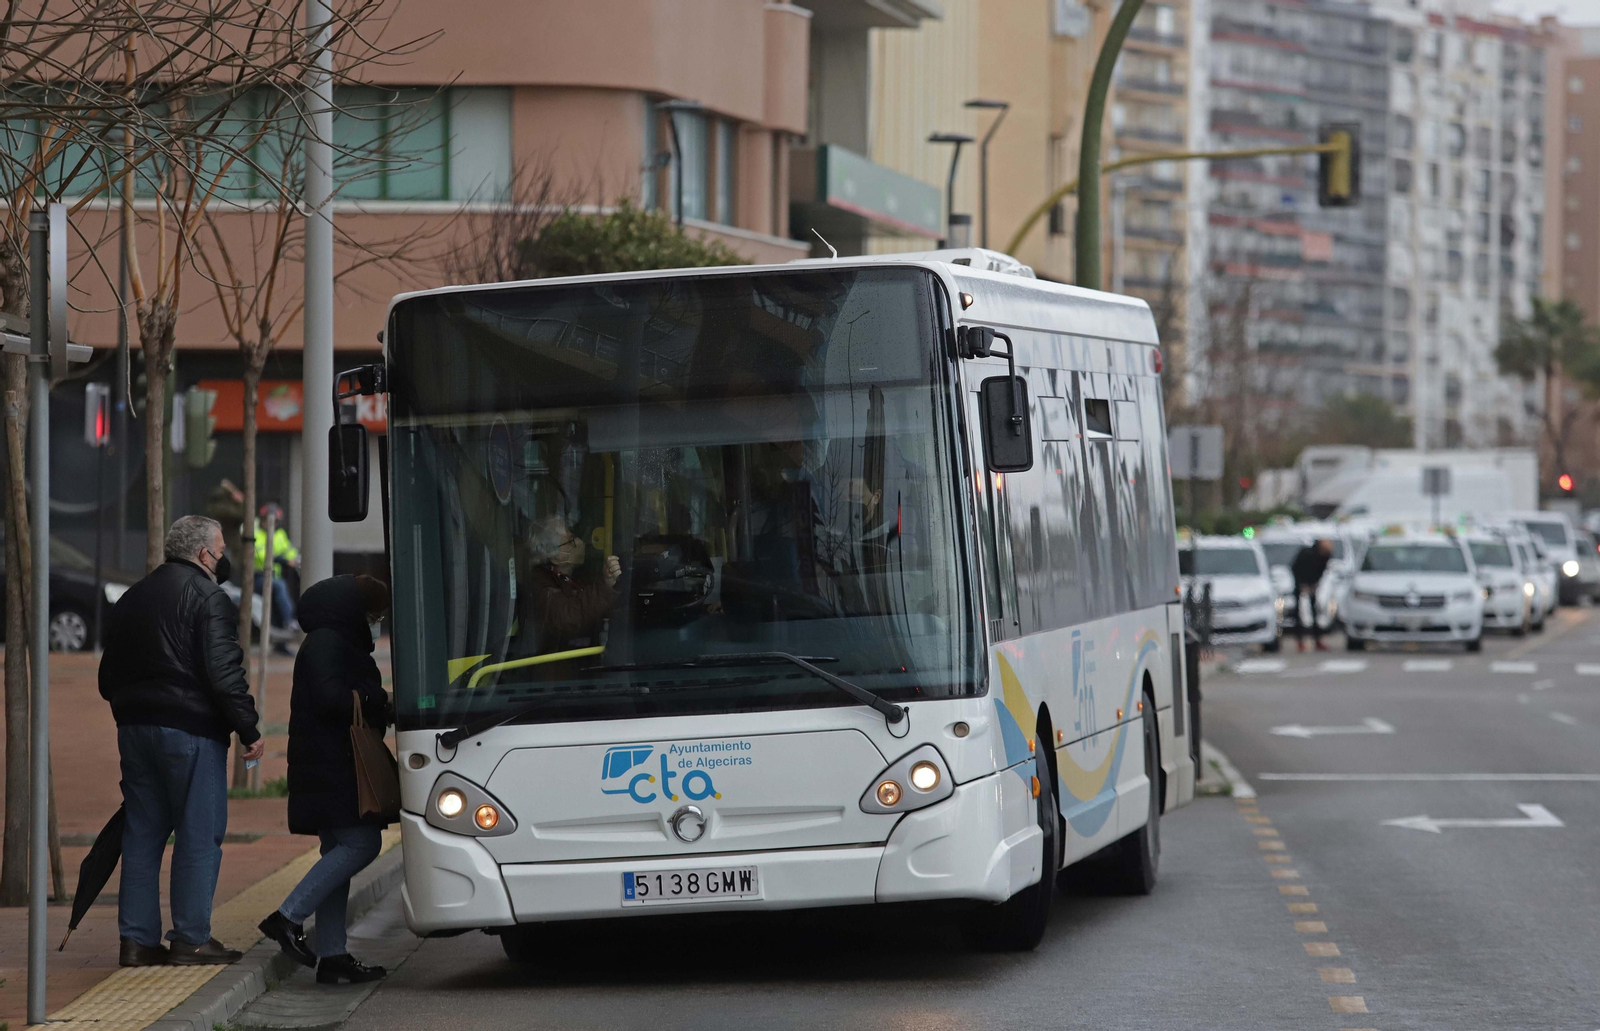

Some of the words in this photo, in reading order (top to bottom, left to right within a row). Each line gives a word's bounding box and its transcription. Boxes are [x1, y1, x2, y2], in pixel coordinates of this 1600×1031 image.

[669, 740, 752, 756] Ayuntamiento
[678, 758, 693, 768] de
[696, 756, 752, 769] Algeciras
[628, 753, 722, 804] cta
